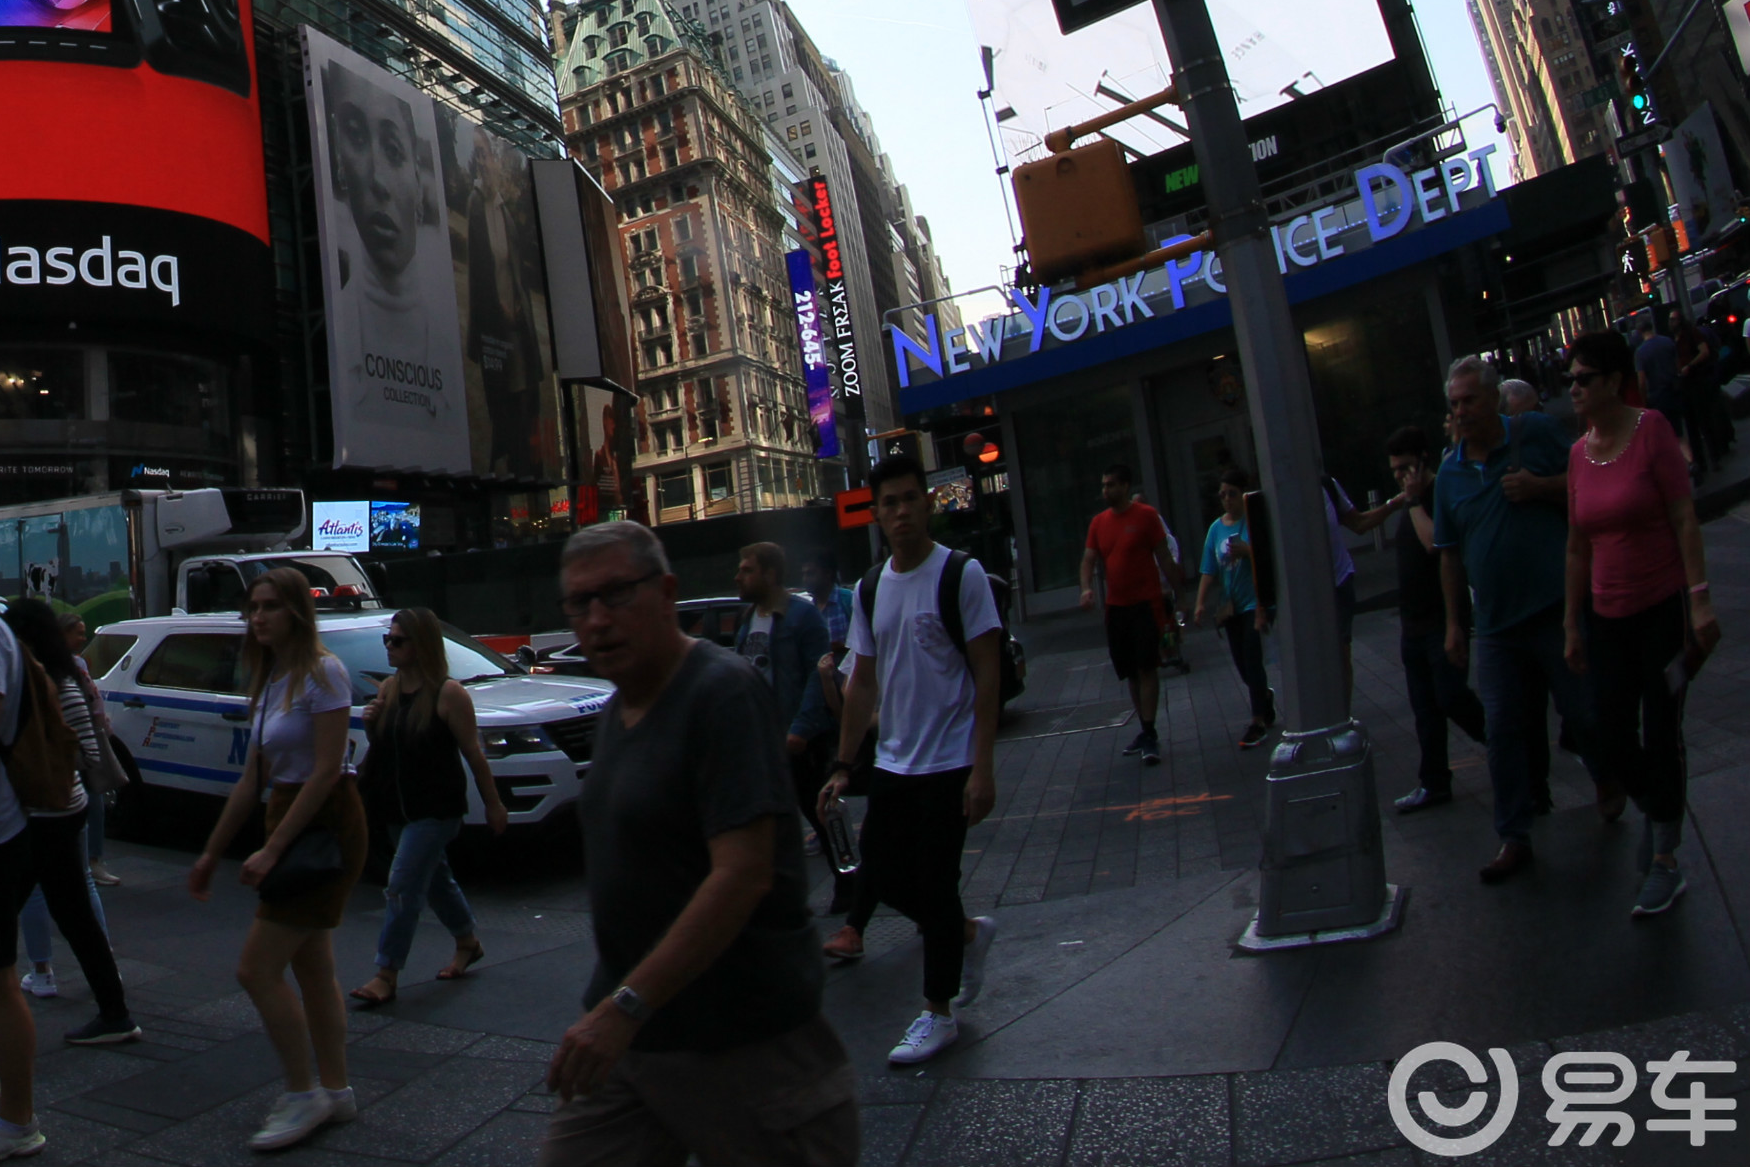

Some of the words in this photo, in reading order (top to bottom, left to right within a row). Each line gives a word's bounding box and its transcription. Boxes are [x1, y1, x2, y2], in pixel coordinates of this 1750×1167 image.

[1248, 135, 1278, 163] ION
[1165, 164, 1199, 194] NEW
[812, 180, 837, 239] Locker
[825, 240, 844, 280] Foot
[890, 313, 1006, 388] NEW
[1012, 272, 1155, 353] YORK
[1159, 205, 1346, 311] POICE
[1353, 143, 1498, 244] DEPT
[365, 352, 443, 391] CONSCIOUS
[840, 342, 861, 398] ZOOM
[383, 386, 432, 409] COLLECTION
[22, 466, 75, 474] TOMORROW
[143, 466, 170, 478] Nasdaq
[318, 519, 364, 538] Atlantis
